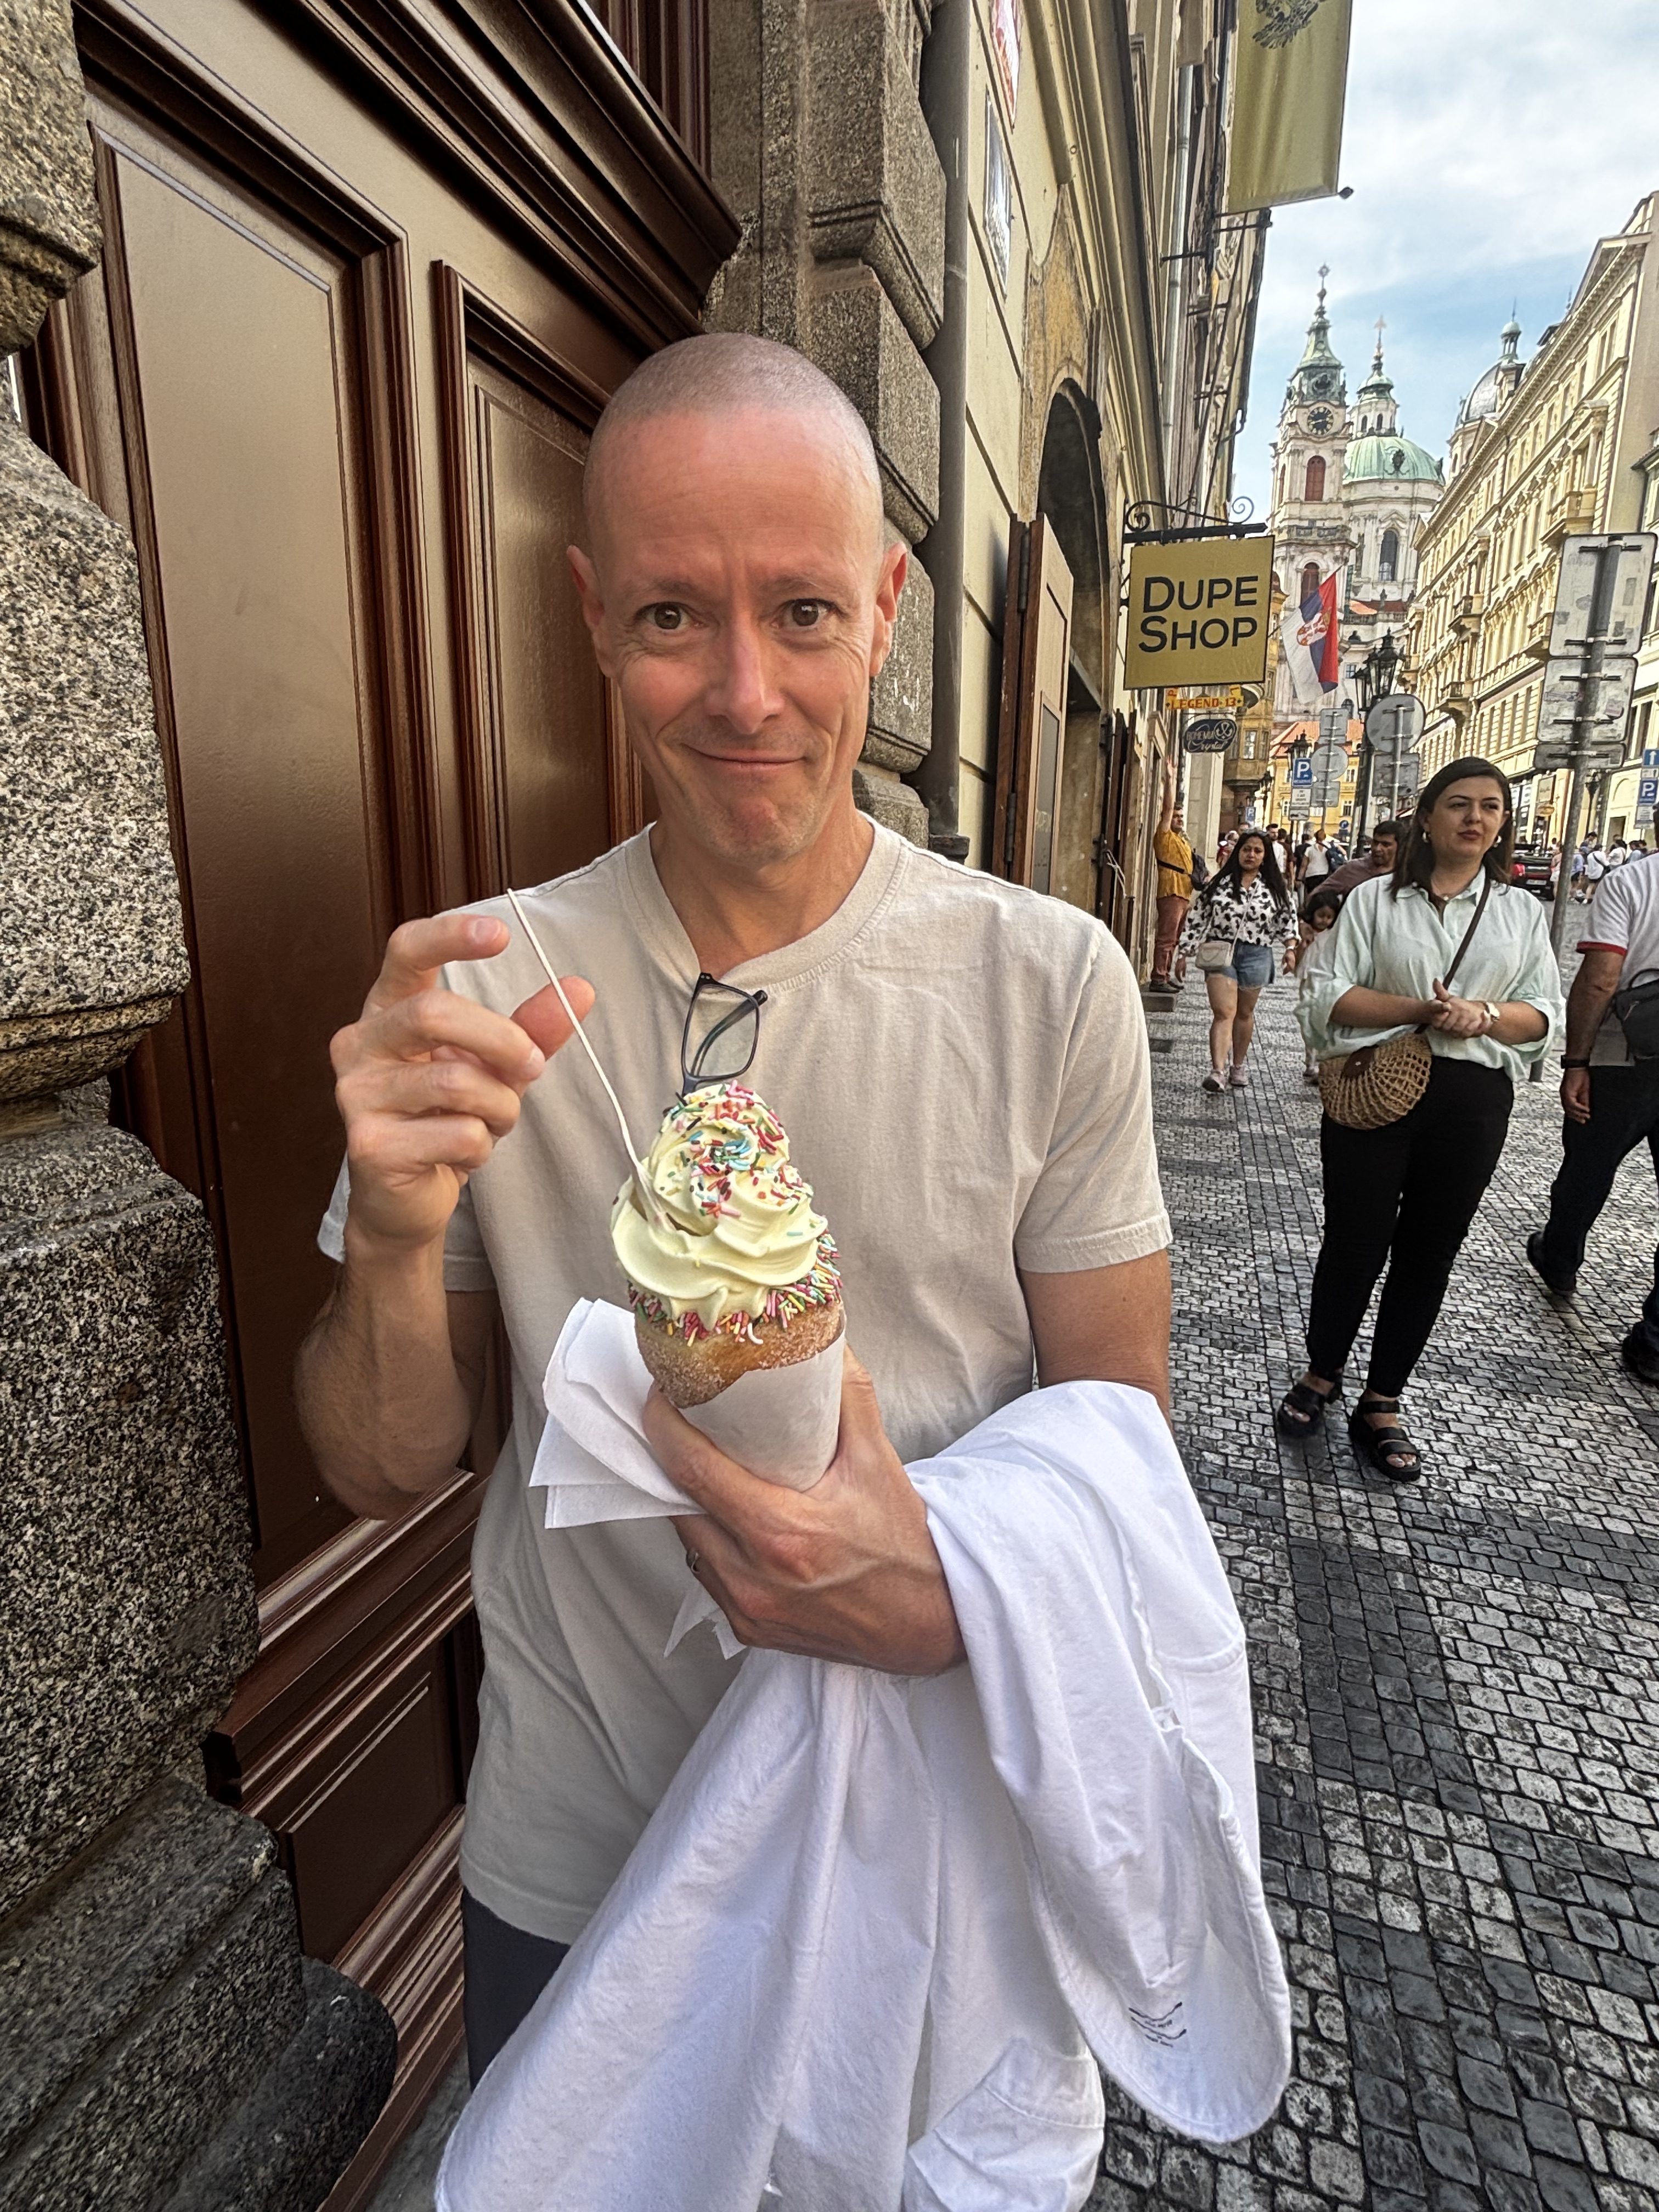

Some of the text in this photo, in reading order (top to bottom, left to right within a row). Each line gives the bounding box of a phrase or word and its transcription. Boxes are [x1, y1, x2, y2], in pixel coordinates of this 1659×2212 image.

[1142, 575, 1259, 613] DUPE
[1138, 615, 1257, 653] SHOP
[1171, 697, 1219, 709] LEGEND
[1297, 761, 1310, 778] P
[1641, 782, 1655, 797] P
